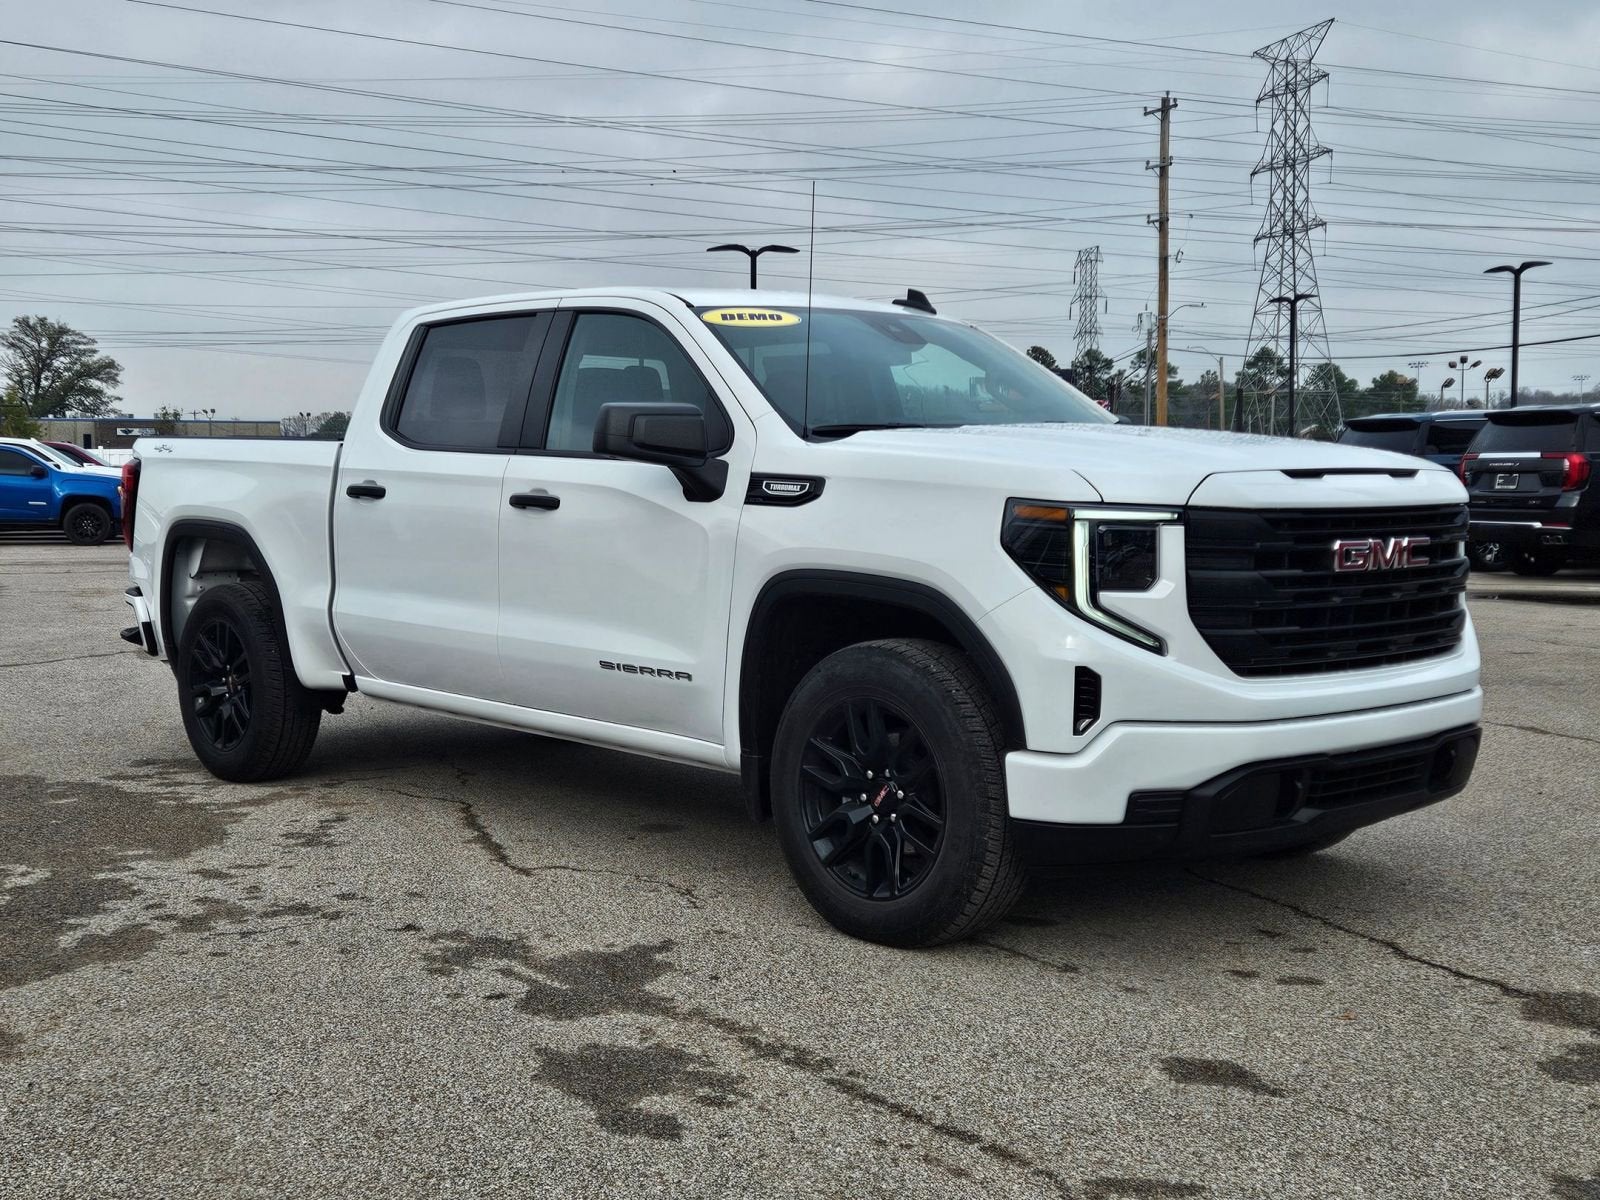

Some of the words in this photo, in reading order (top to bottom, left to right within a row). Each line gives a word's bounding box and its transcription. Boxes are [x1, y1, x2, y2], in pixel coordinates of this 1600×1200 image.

[720, 313, 783, 321] DEMO
[1332, 537, 1430, 572] GMC
[599, 660, 693, 682] SIERRA
